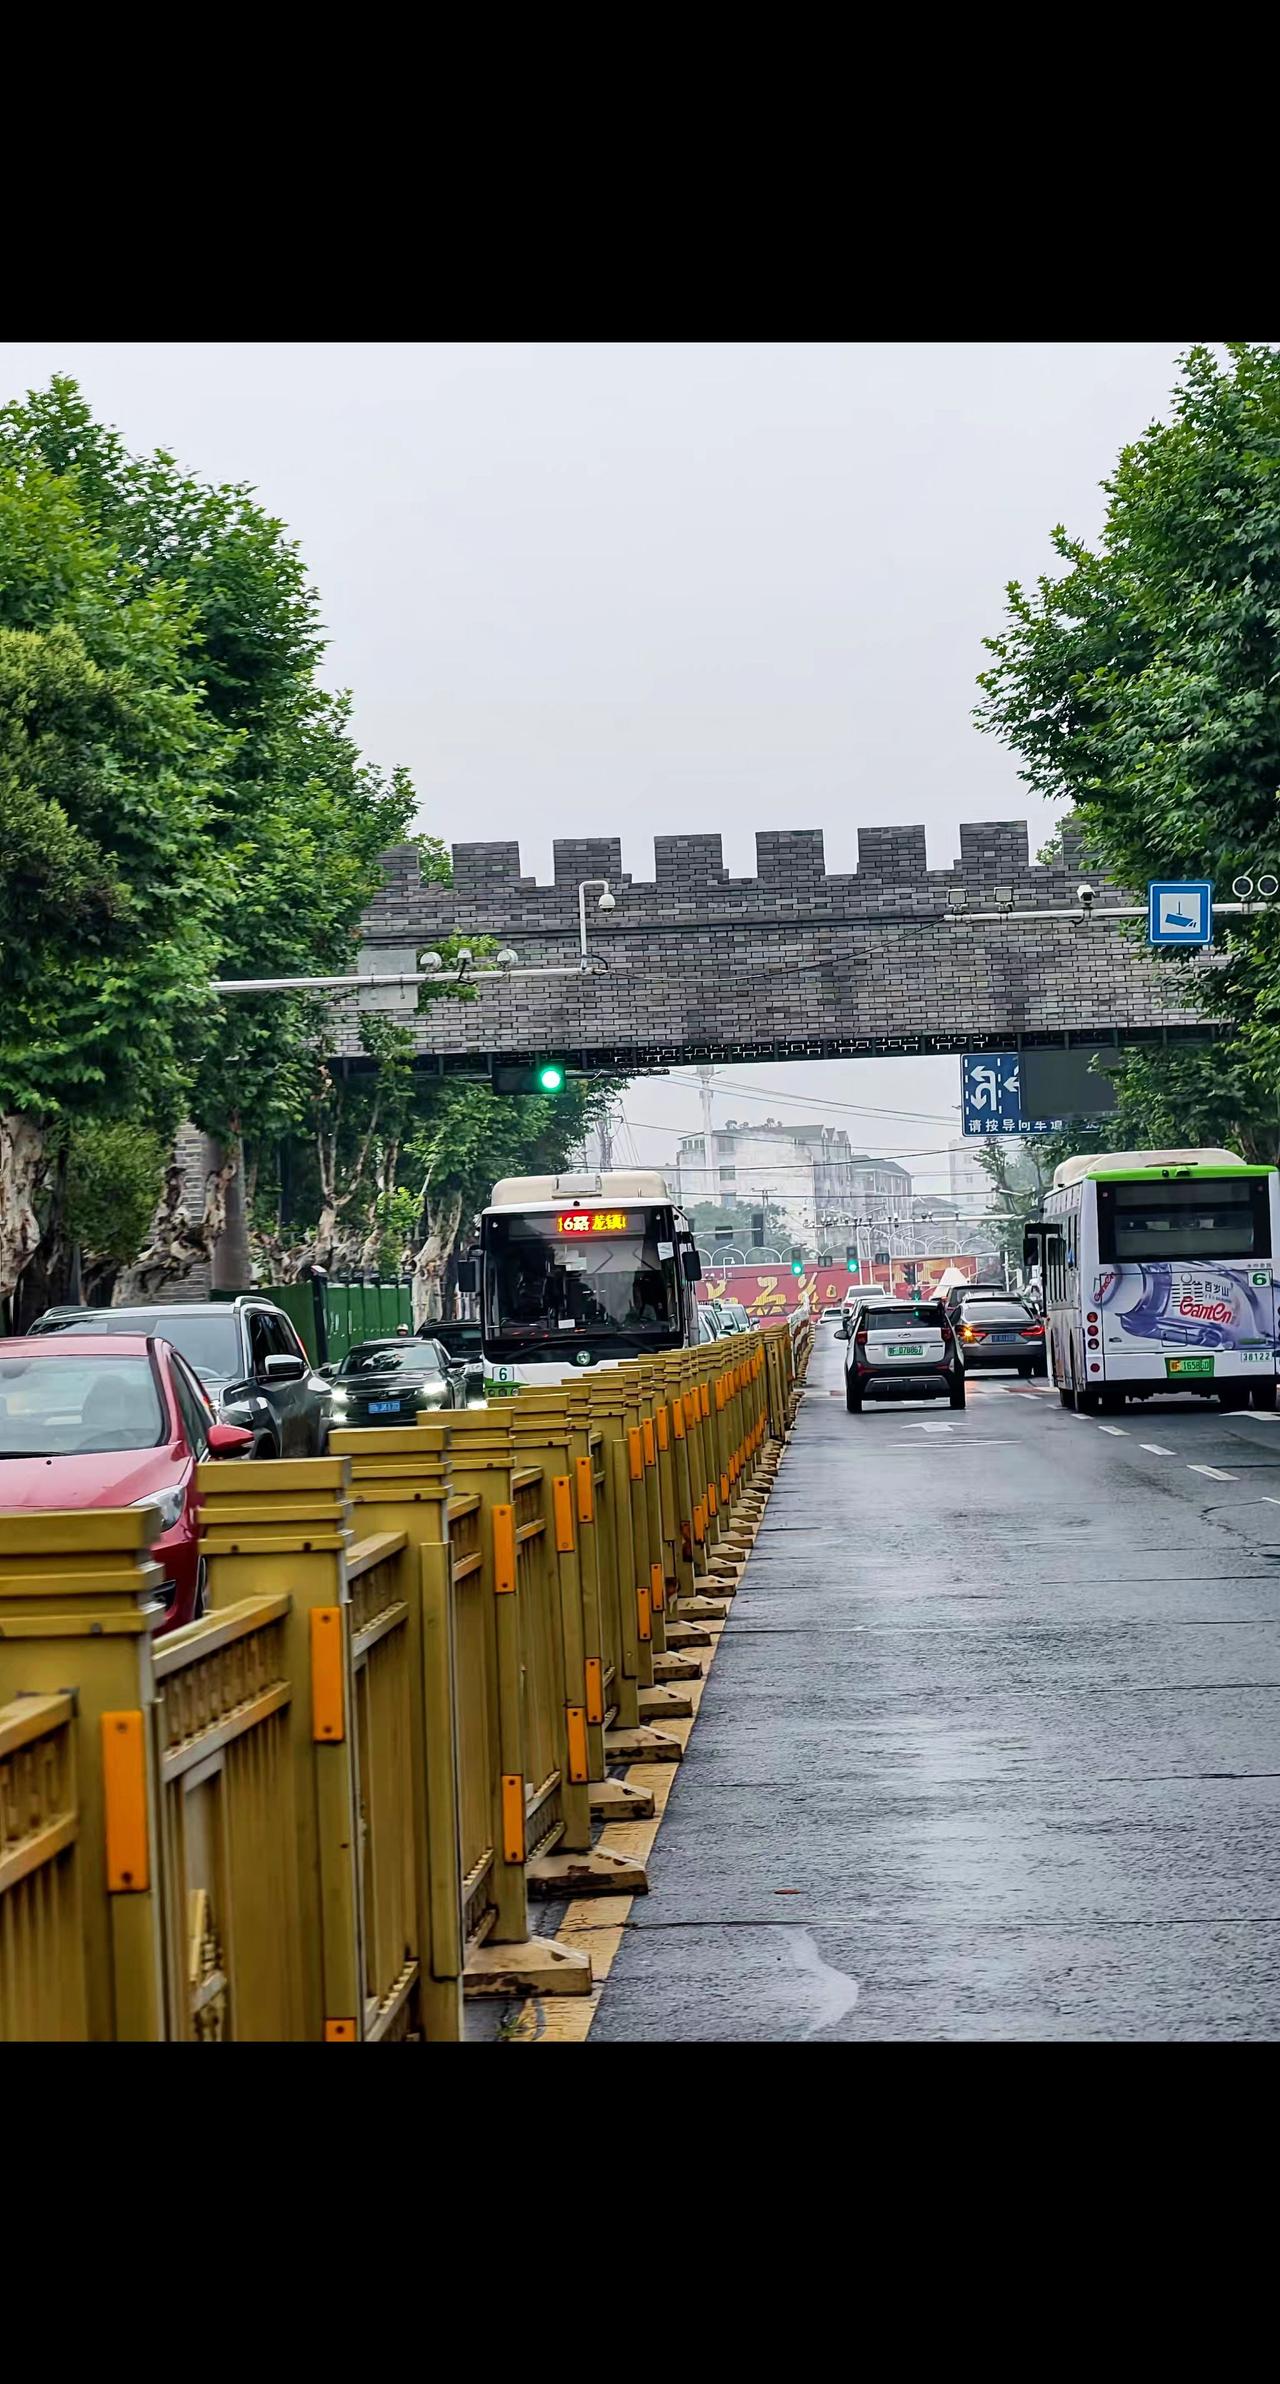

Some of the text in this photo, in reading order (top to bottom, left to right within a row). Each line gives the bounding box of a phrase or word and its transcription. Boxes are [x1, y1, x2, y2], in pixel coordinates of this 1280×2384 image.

[1252, 1273, 1267, 1286] 6
[1204, 1281, 1230, 1297] 百岁山
[1243, 1353, 1270, 1361] 38122
[500, 1367, 508, 1381] 6
